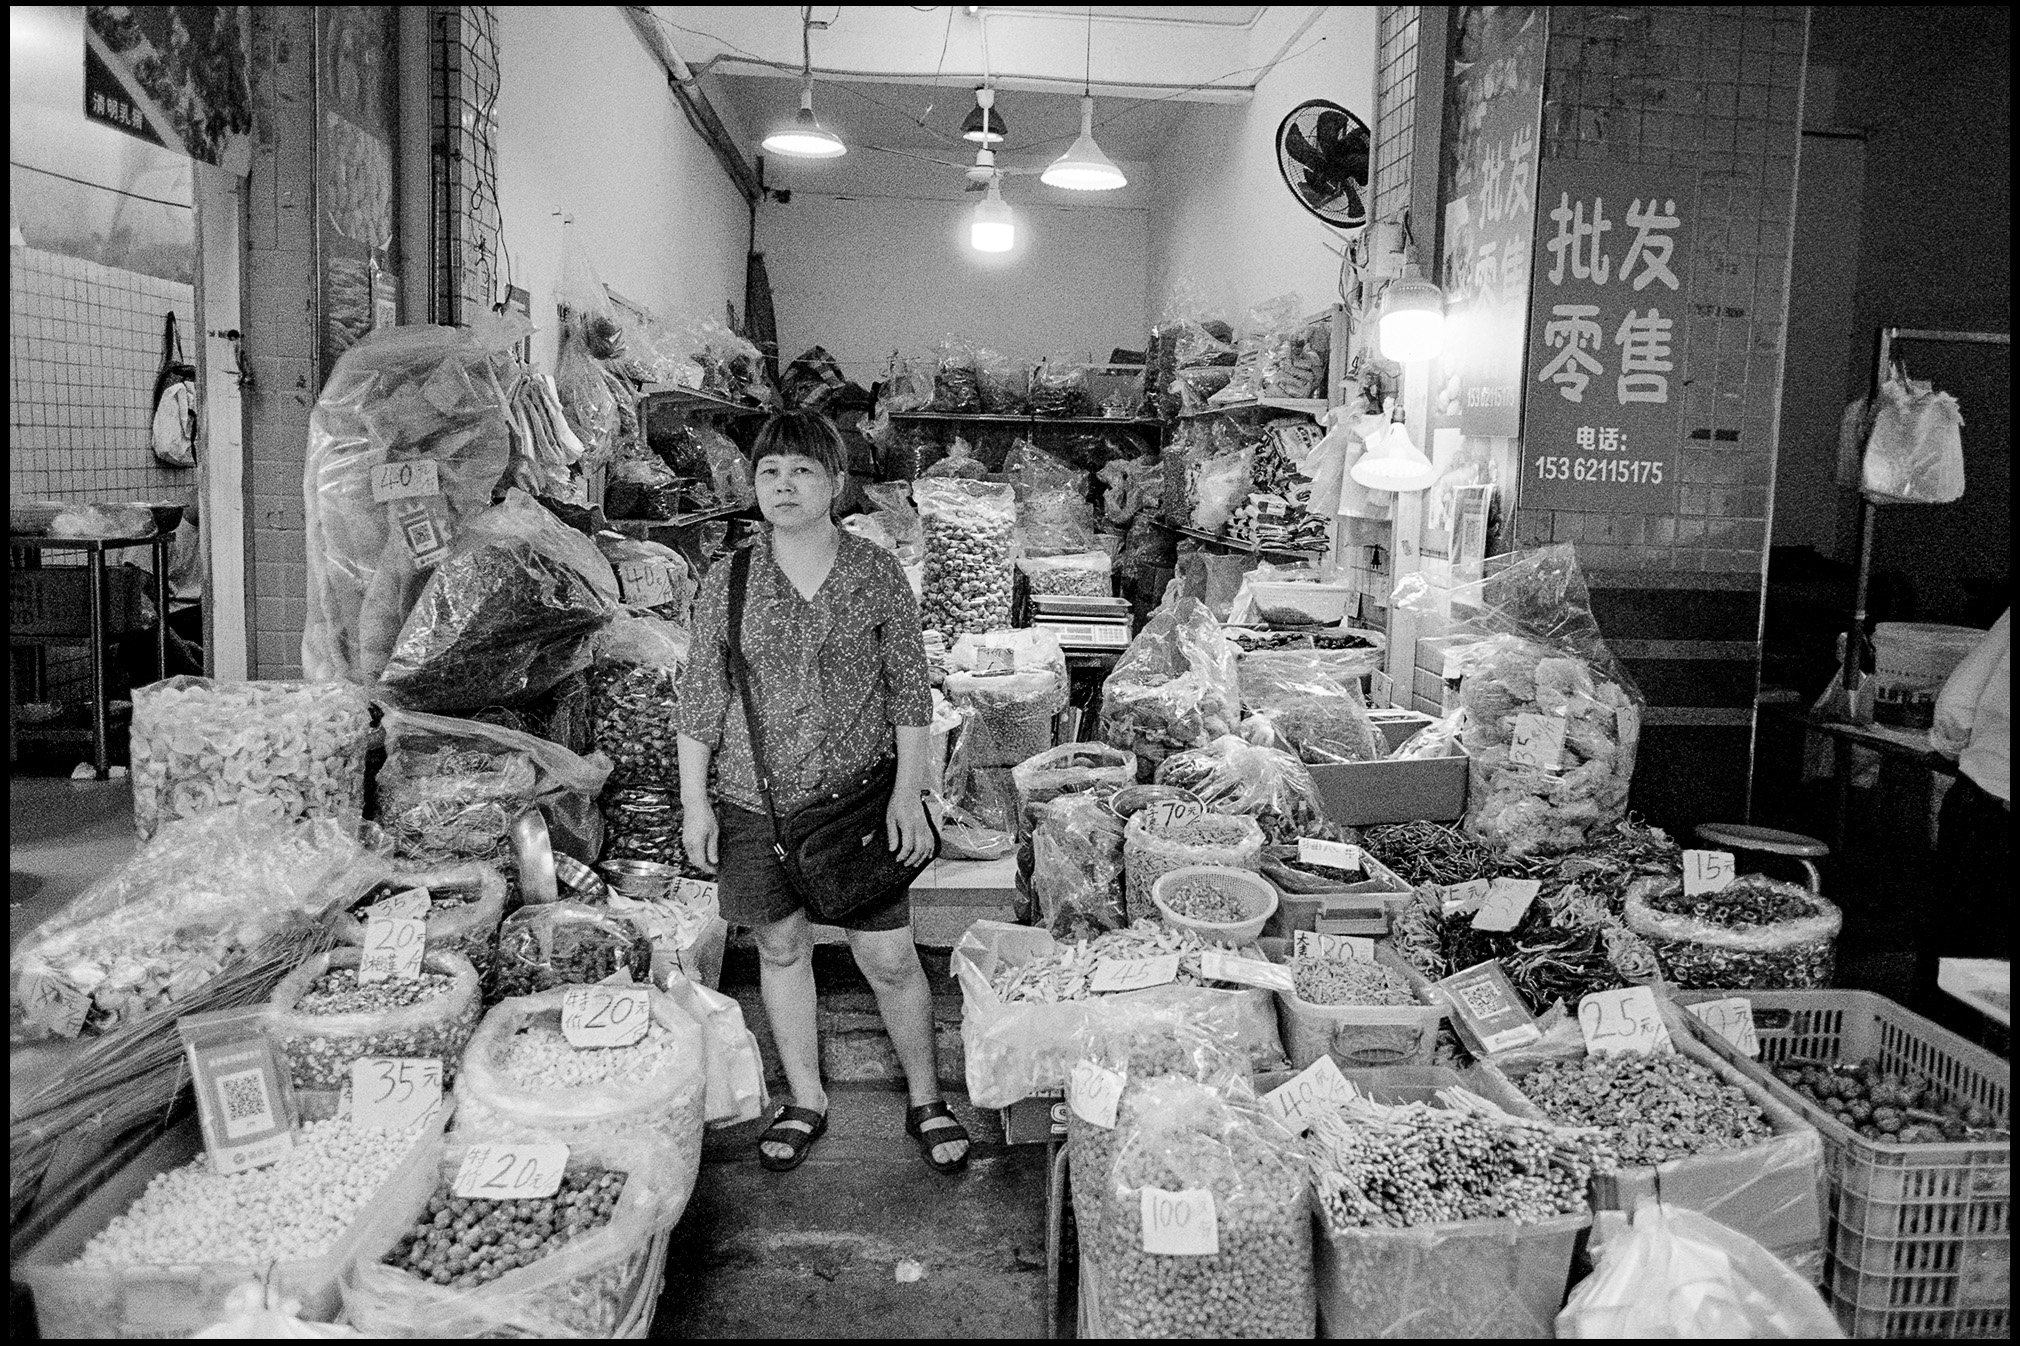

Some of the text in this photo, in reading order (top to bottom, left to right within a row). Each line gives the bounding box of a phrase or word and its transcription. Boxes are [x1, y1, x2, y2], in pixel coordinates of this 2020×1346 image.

[1479, 123, 1532, 230] 批发
[1547, 191, 1681, 291] 批发
[1538, 304, 1674, 404] 零售
[1576, 425, 1628, 451] 电话:
